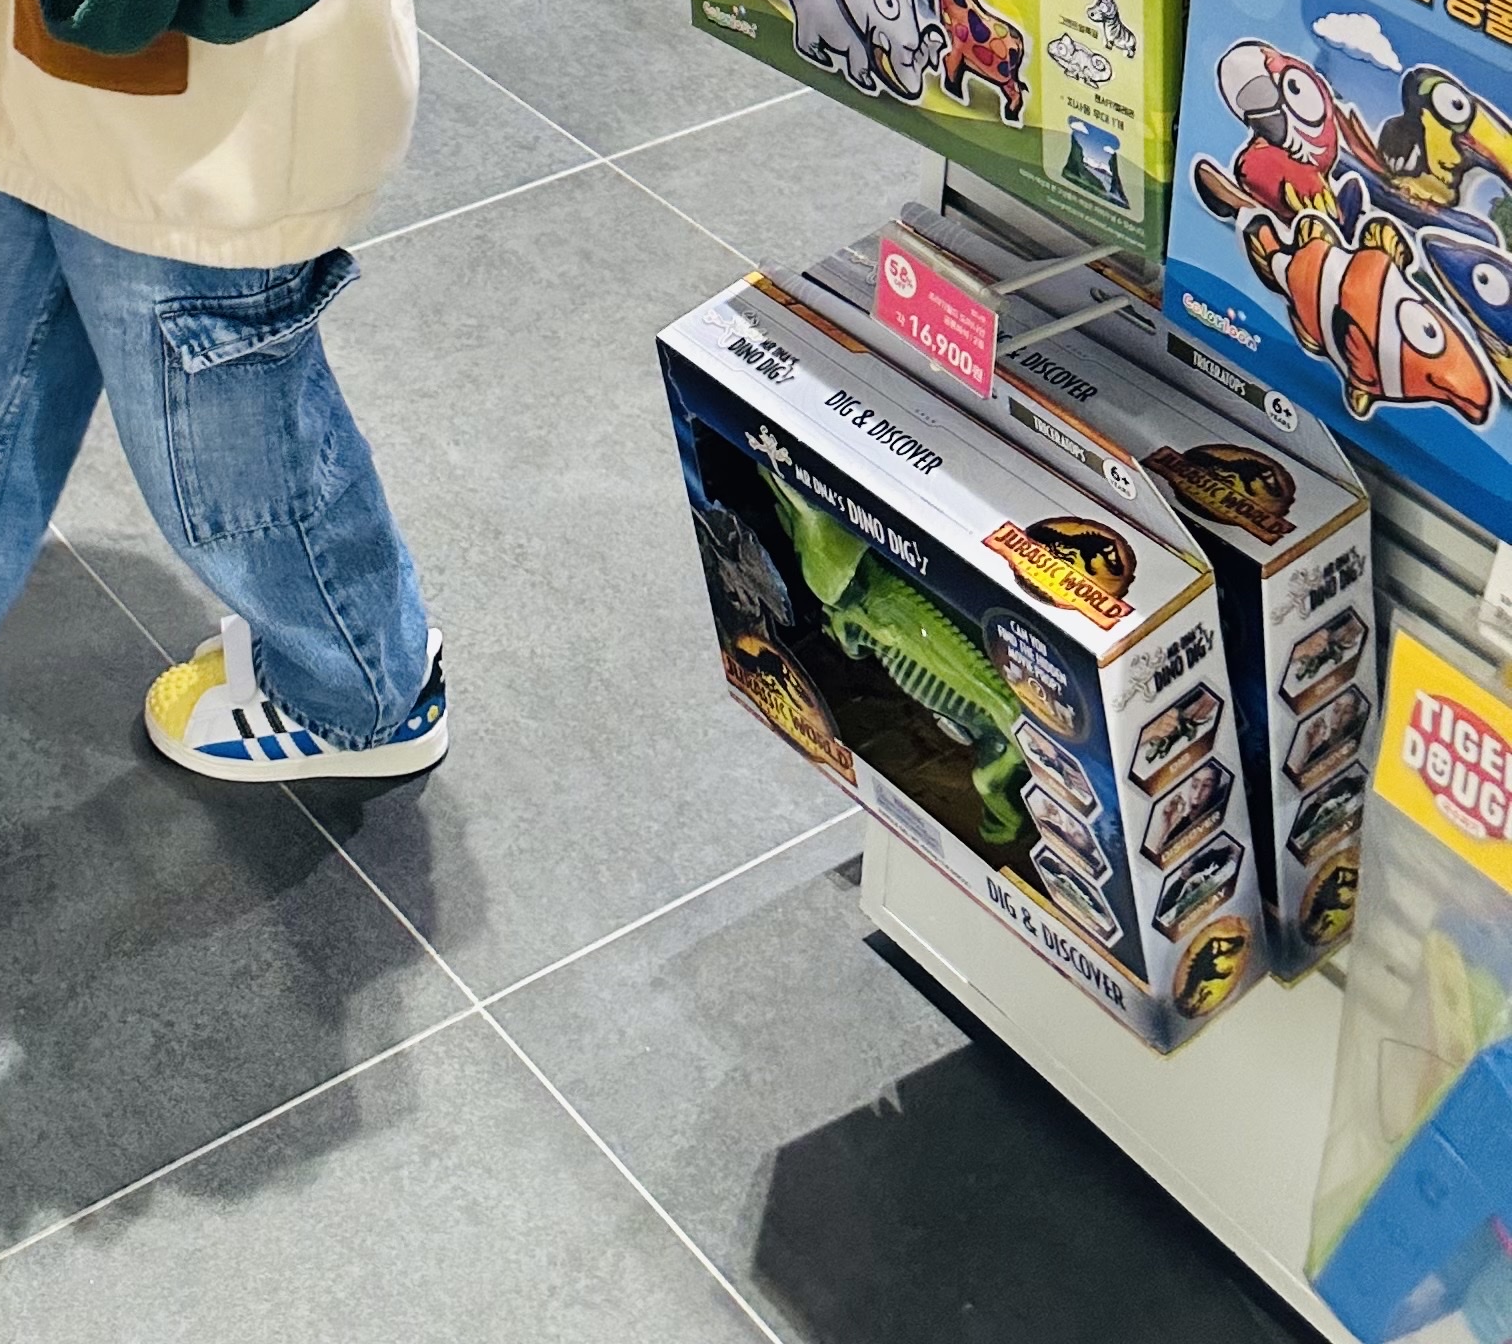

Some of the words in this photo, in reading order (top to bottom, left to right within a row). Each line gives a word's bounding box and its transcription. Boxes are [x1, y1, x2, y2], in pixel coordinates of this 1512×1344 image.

[726, 336, 755, 371] DINO
[909, 312, 985, 384] 16,900원
[1018, 347, 1099, 405] DISCOVER
[1192, 350, 1247, 398] TRICERATOPS
[1271, 397, 1294, 420] 6+
[824, 388, 853, 418] DIG
[851, 409, 868, 430] &
[869, 419, 944, 476] DISCOVER
[1031, 417, 1087, 463] TRICERATOPS
[1108, 464, 1132, 488] 6+
[794, 464, 814, 490] MR
[812, 475, 847, 513] DNA'S
[846, 492, 886, 545] DINO
[995, 524, 1063, 582] JURASSIC
[1059, 573, 1124, 622] WORLD
[1414, 689, 1512, 782] TIGE
[1403, 726, 1512, 839] DOUG
[987, 876, 1019, 920] DIG
[1020, 909, 1038, 936] &
[1040, 920, 1127, 1012] DISCOVER
